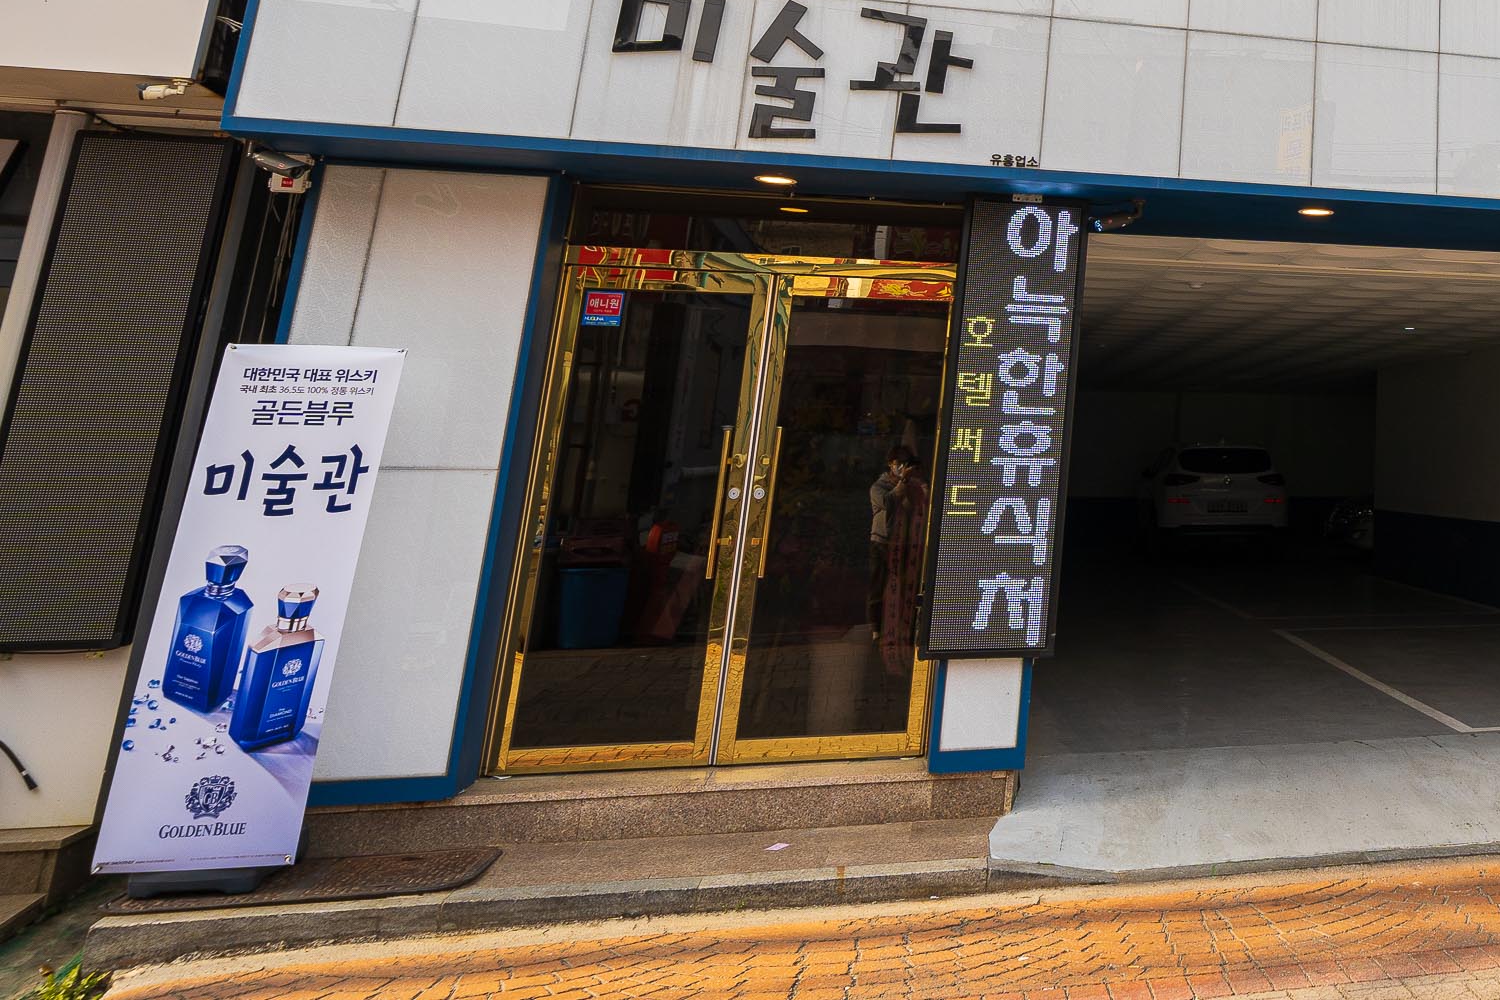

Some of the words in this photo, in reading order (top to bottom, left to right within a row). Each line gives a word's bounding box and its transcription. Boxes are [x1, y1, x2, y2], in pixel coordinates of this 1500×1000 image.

[990, 153, 1039, 168] 유흥업소
[590, 298, 620, 309] 애니원
[243, 367, 301, 382] 대한민국
[303, 368, 333, 382] 대표
[335, 369, 378, 383] 위스키
[239, 384, 258, 394] 국내
[259, 385, 277, 394] 최초
[307, 386, 329, 395] 100%
[349, 387, 375, 396] 위스키
[251, 400, 354, 426] 골든블루
[203, 444, 369, 517] 미술관
